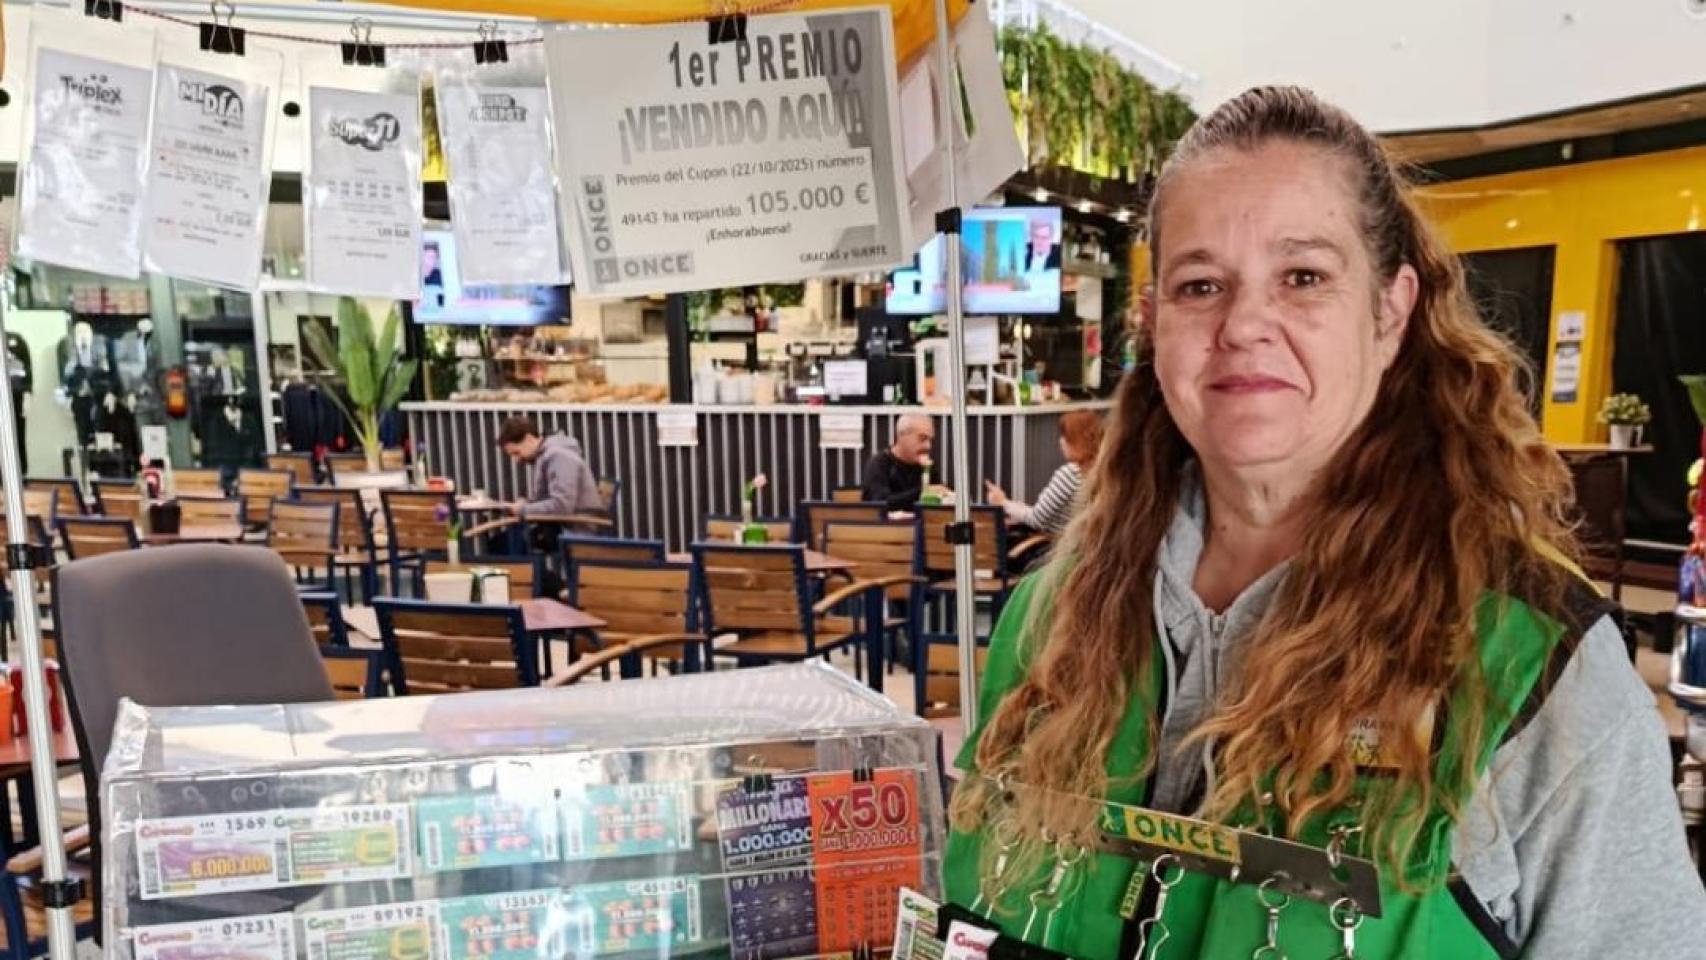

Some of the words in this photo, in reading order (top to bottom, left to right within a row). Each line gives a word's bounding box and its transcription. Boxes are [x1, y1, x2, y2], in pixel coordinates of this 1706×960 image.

[669, 41, 719, 88] 1er
[736, 27, 862, 83] PREMIO
[618, 97, 768, 166] ¡VENDIDO
[616, 172, 660, 187] Premio
[664, 168, 684, 184] del
[731, 157, 814, 179] (22/10/2025)
[585, 180, 612, 252] ONCE
[662, 210, 680, 223] ha
[683, 203, 742, 224] repartido
[746, 183, 844, 215] 105.000
[855, 182, 871, 205] €
[623, 253, 691, 277] ONCE
[1134, 813, 1233, 857] ONCE
